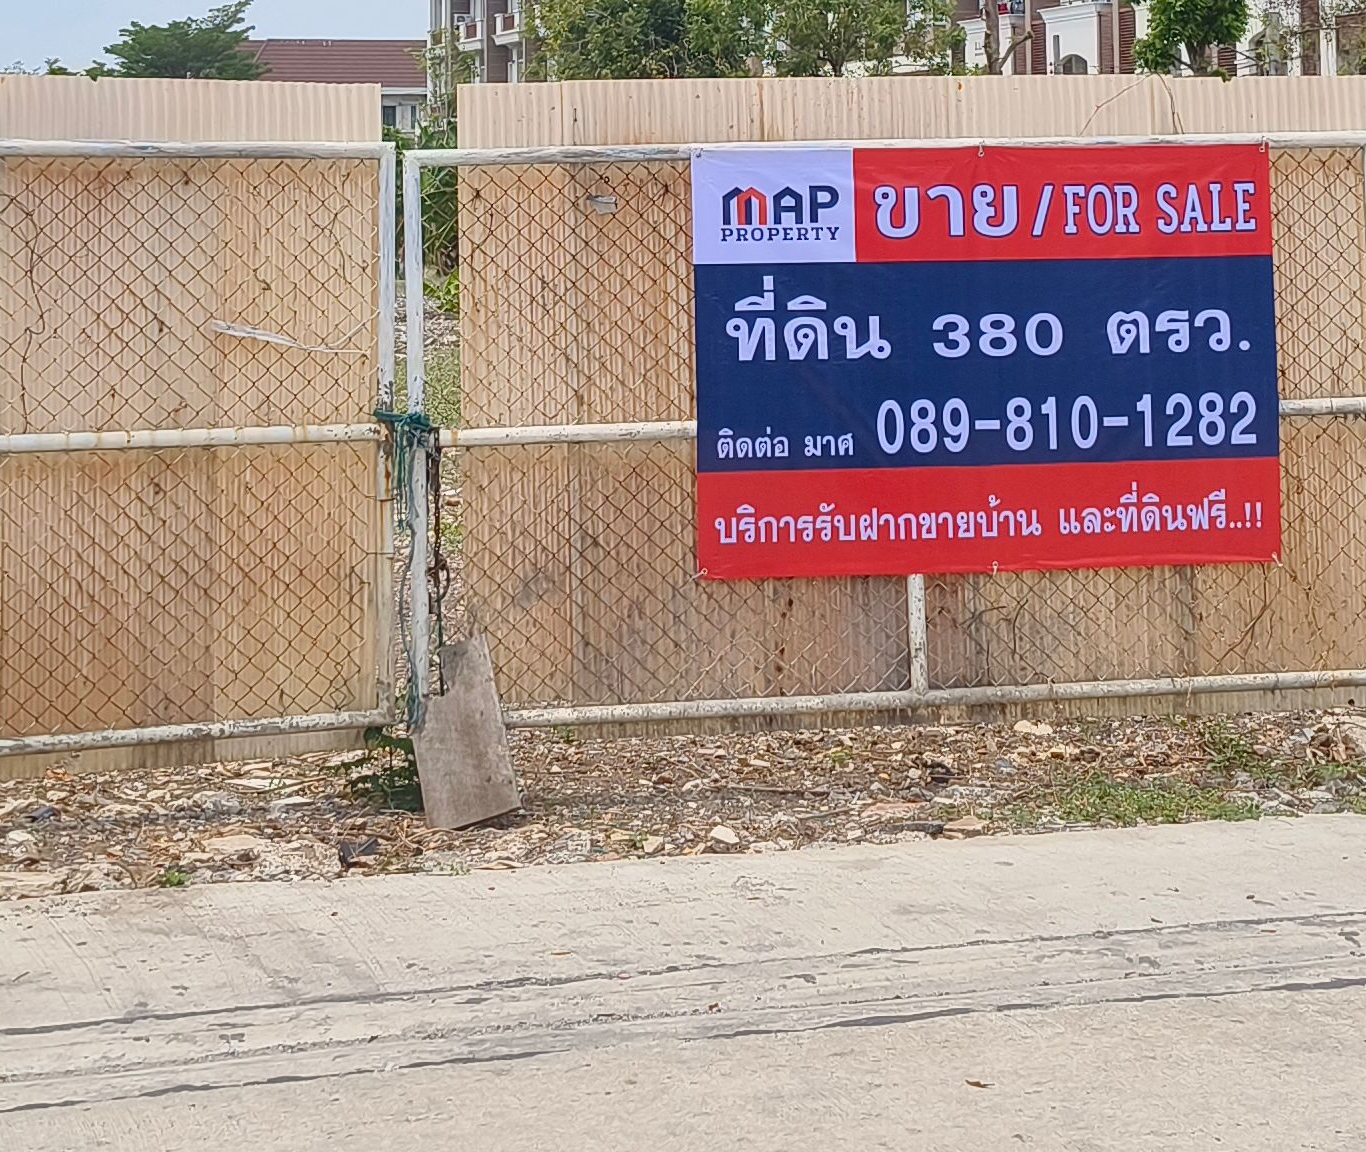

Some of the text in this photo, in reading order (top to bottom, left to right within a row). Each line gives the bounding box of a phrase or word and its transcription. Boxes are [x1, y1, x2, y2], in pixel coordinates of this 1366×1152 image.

[722, 185, 840, 225] MAP
[873, 183, 1019, 239] ขาย
[1156, 182, 1257, 234] SALE
[721, 226, 840, 242] PROPERTY
[725, 276, 1251, 361] ที่ดิน 380 ตรว.
[717, 391, 1257, 459] ติดต่อ มาศ 089-810-1282
[714, 494, 1042, 544] บริการรับฝากขายบ้าน
